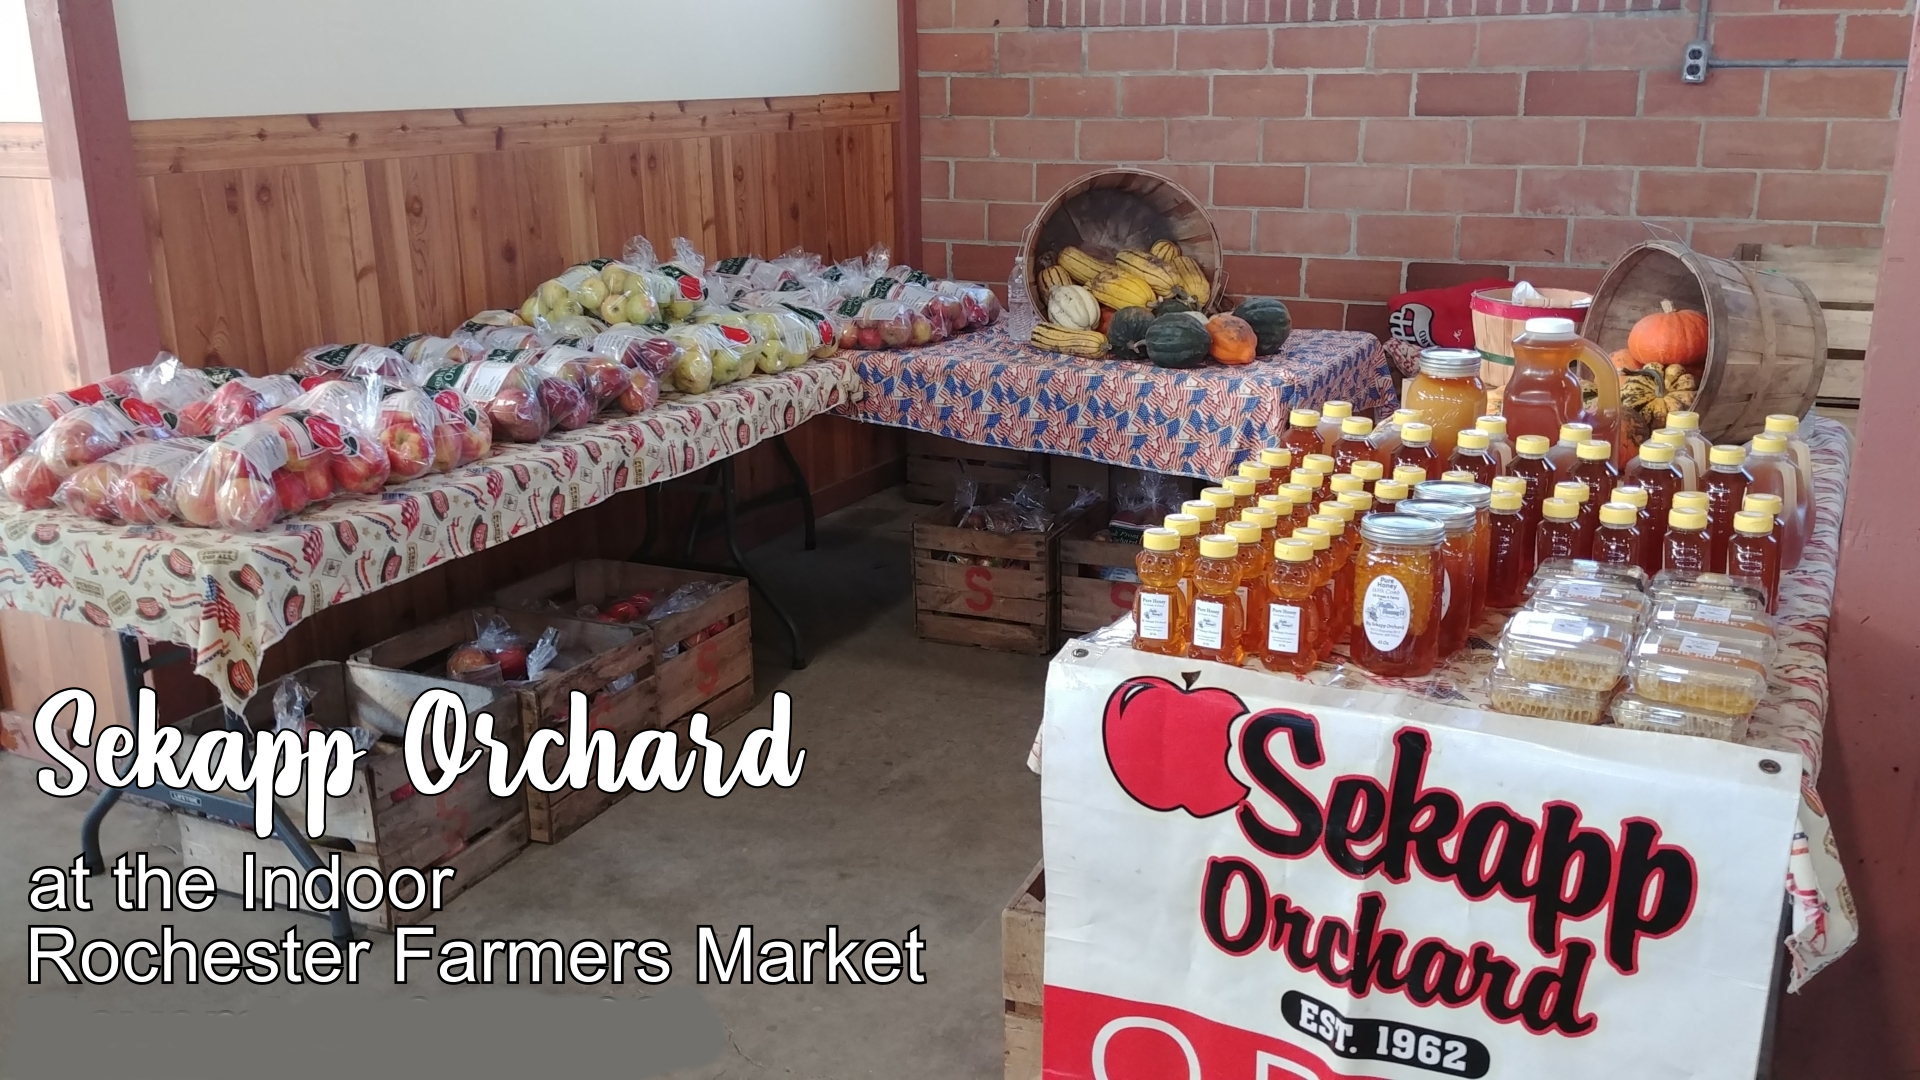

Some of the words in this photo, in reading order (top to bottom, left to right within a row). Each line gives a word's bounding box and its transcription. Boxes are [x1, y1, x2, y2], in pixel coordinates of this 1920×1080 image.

[965, 567, 994, 612] S
[1377, 582, 1398, 590] Honey
[1236, 707, 1699, 976] Sekapp
[1200, 856, 1598, 1038] Orchard
[1299, 999, 1358, 1054] EST.
[1375, 1024, 1467, 1072] 1962
